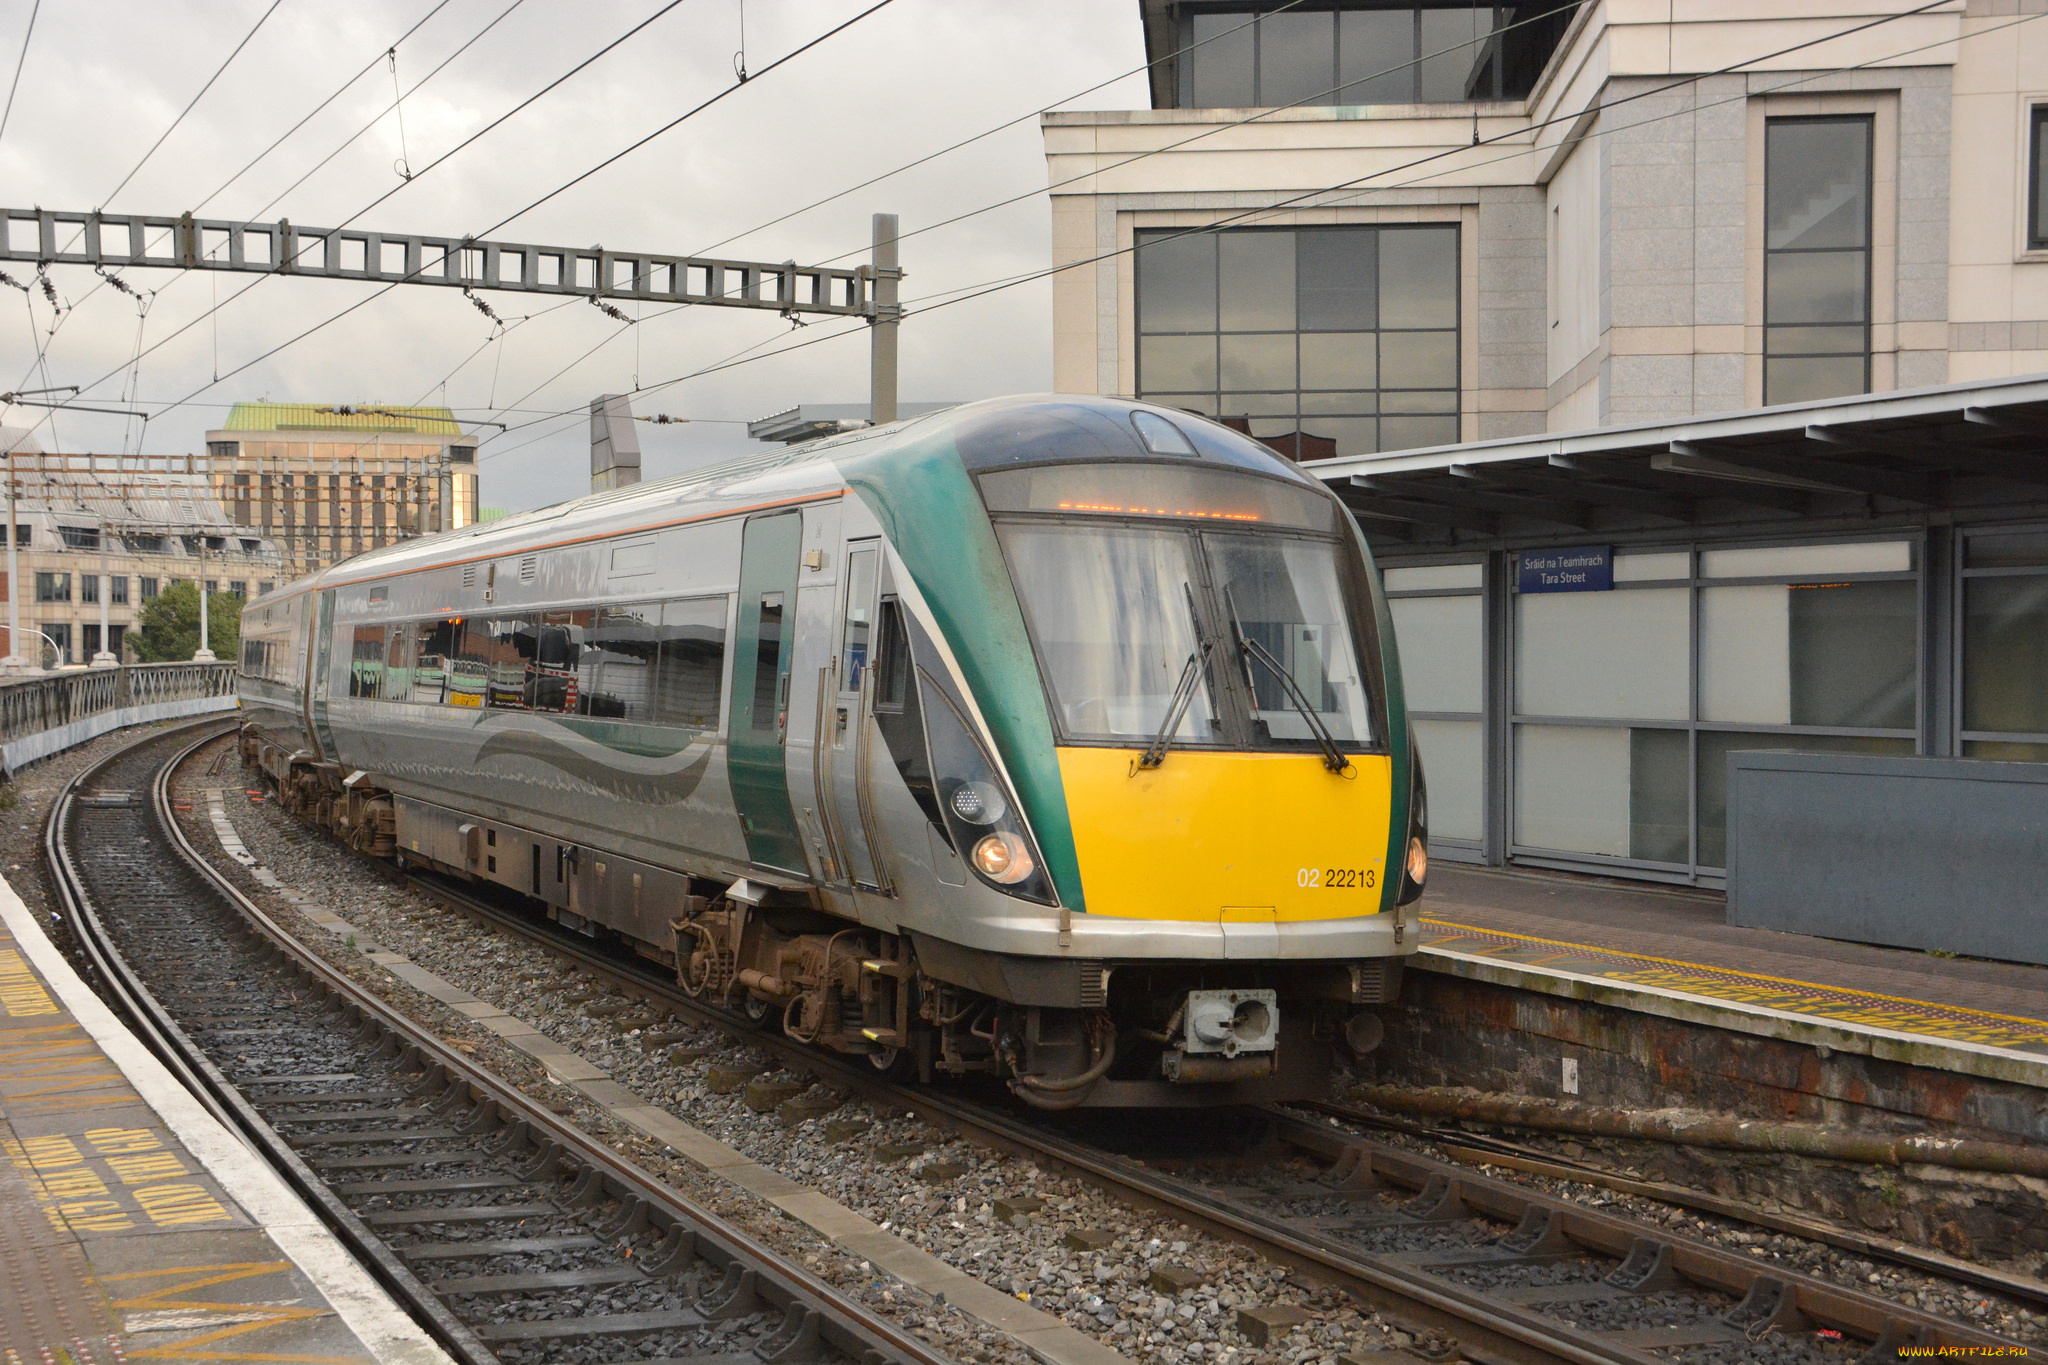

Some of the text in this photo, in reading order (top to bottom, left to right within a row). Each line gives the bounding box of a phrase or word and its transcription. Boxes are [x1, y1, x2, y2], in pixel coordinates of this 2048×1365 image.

[1525, 554, 1603, 570] Sráid na Teamhrach
[1540, 571, 1586, 585] Tara Street
[1297, 868, 1375, 888] 02 22213
[85, 1127, 164, 1153] GAP
